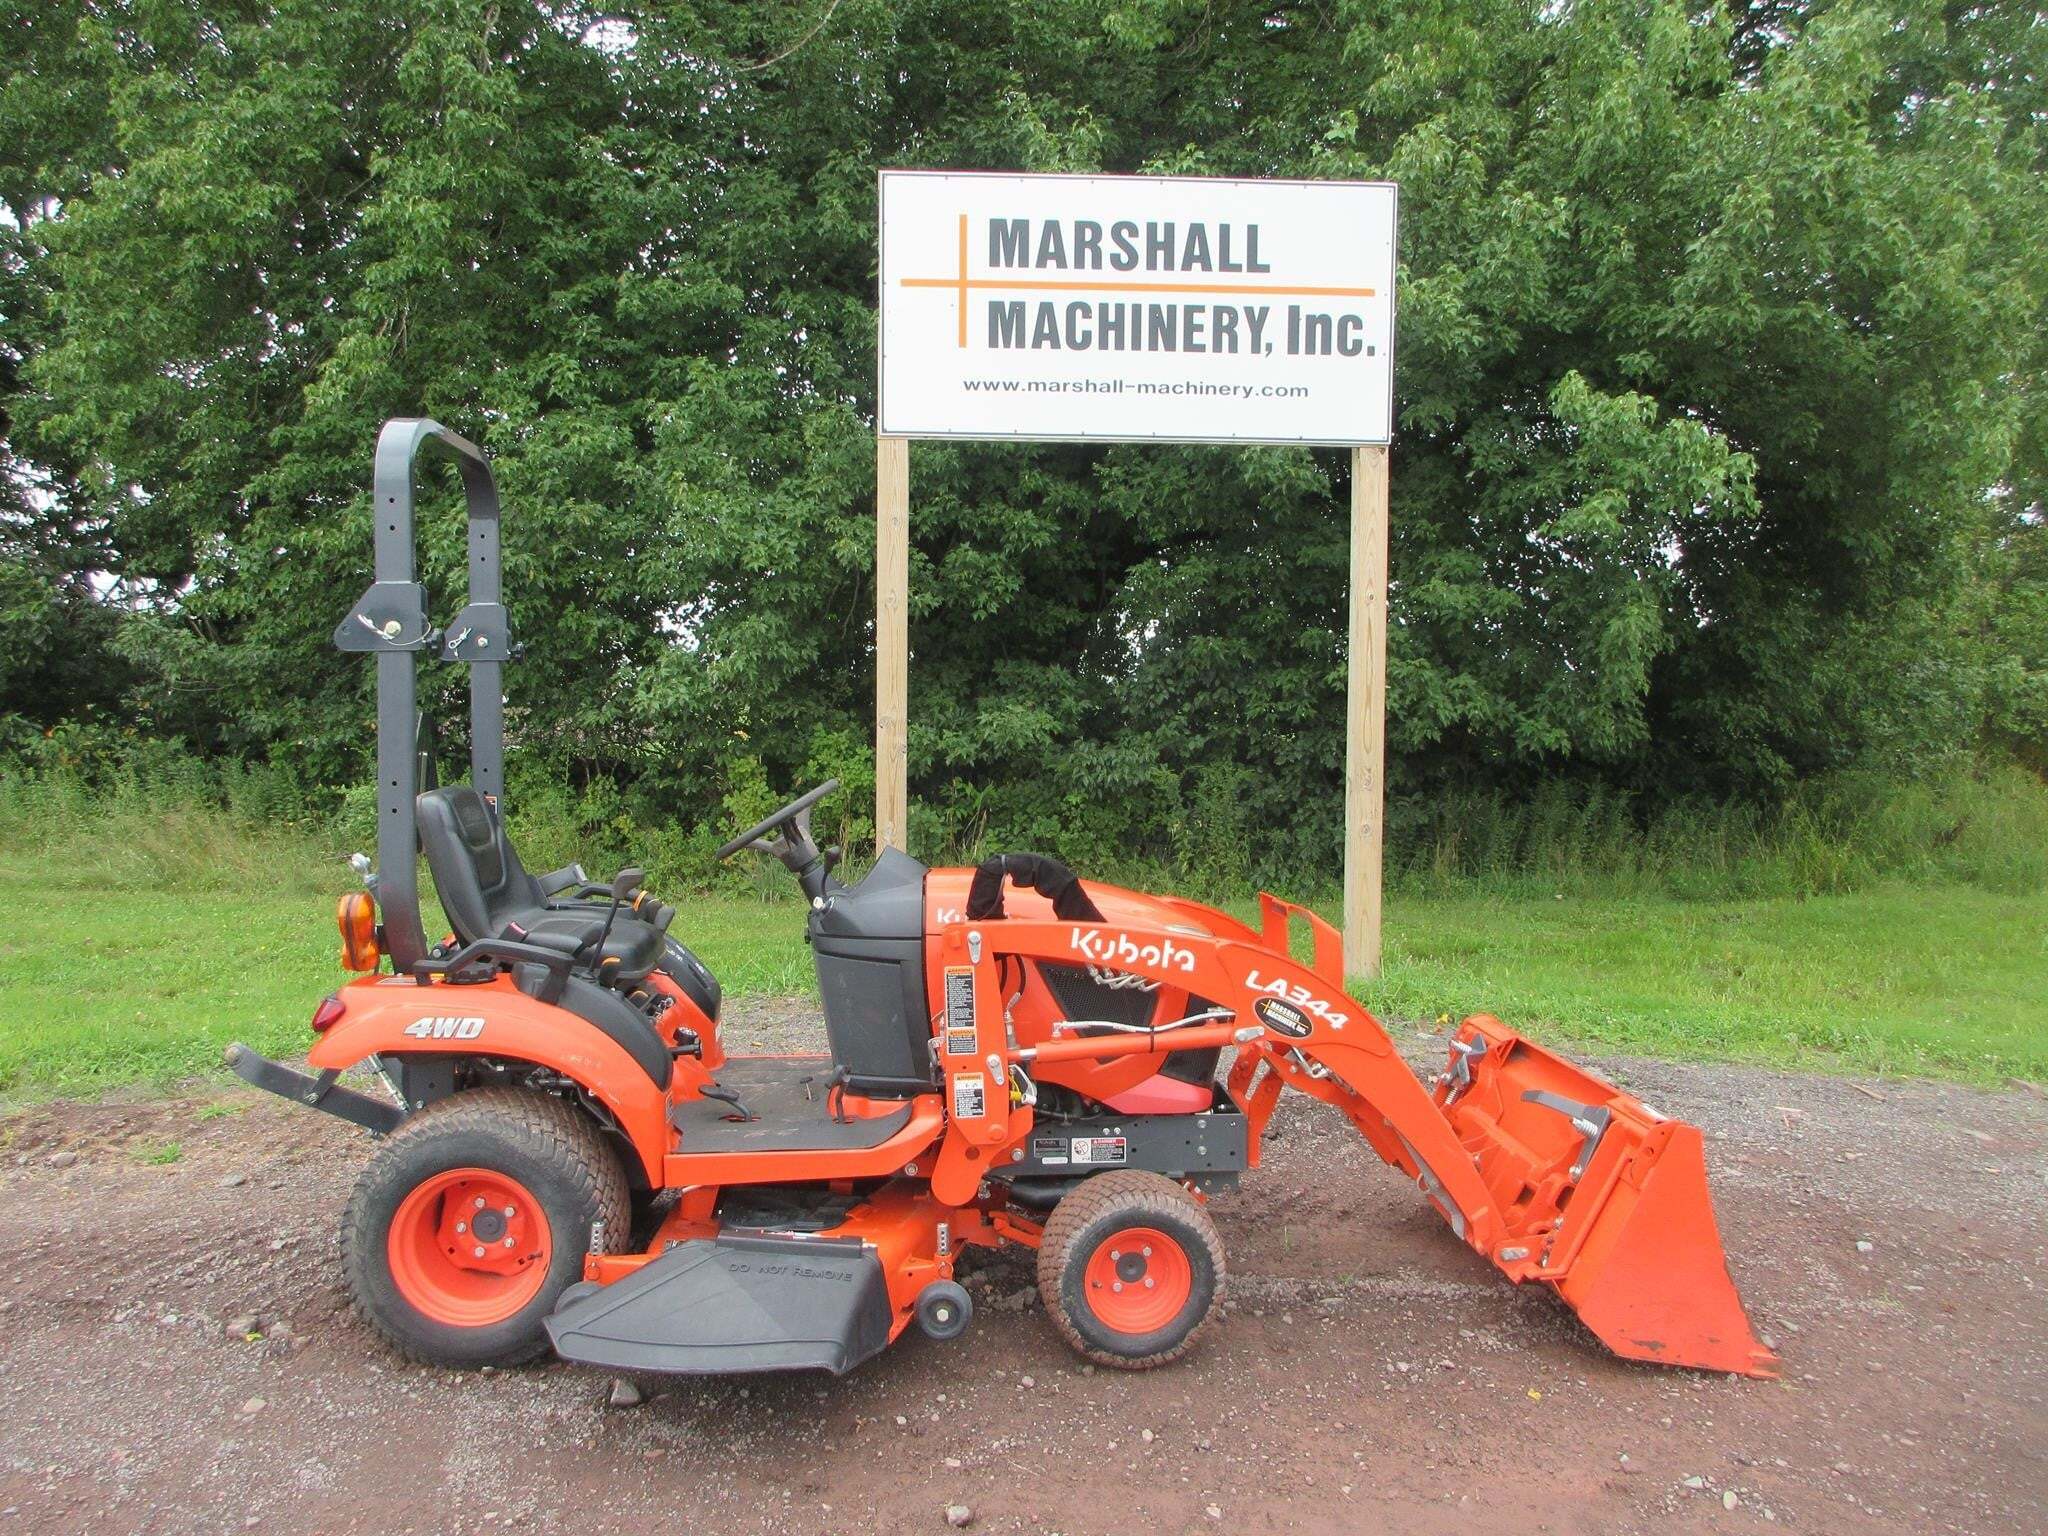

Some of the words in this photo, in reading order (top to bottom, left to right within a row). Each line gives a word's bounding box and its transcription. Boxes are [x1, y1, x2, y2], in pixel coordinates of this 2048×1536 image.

[989, 218, 1271, 273] MARSHALL
[988, 301, 1273, 358] MACHINERY,
[1287, 304, 1376, 357] Inc.
[963, 379, 1309, 399] www.marshall-machinery.com
[1070, 927, 1196, 972] Kubota
[1245, 970, 1349, 1031] LA344
[1270, 1001, 1301, 1022] MARSHALL
[403, 1016, 486, 1040] 4WD
[728, 1263, 751, 1273] DO
[758, 1264, 789, 1276] NOT
[792, 1267, 854, 1282] REMOVE
